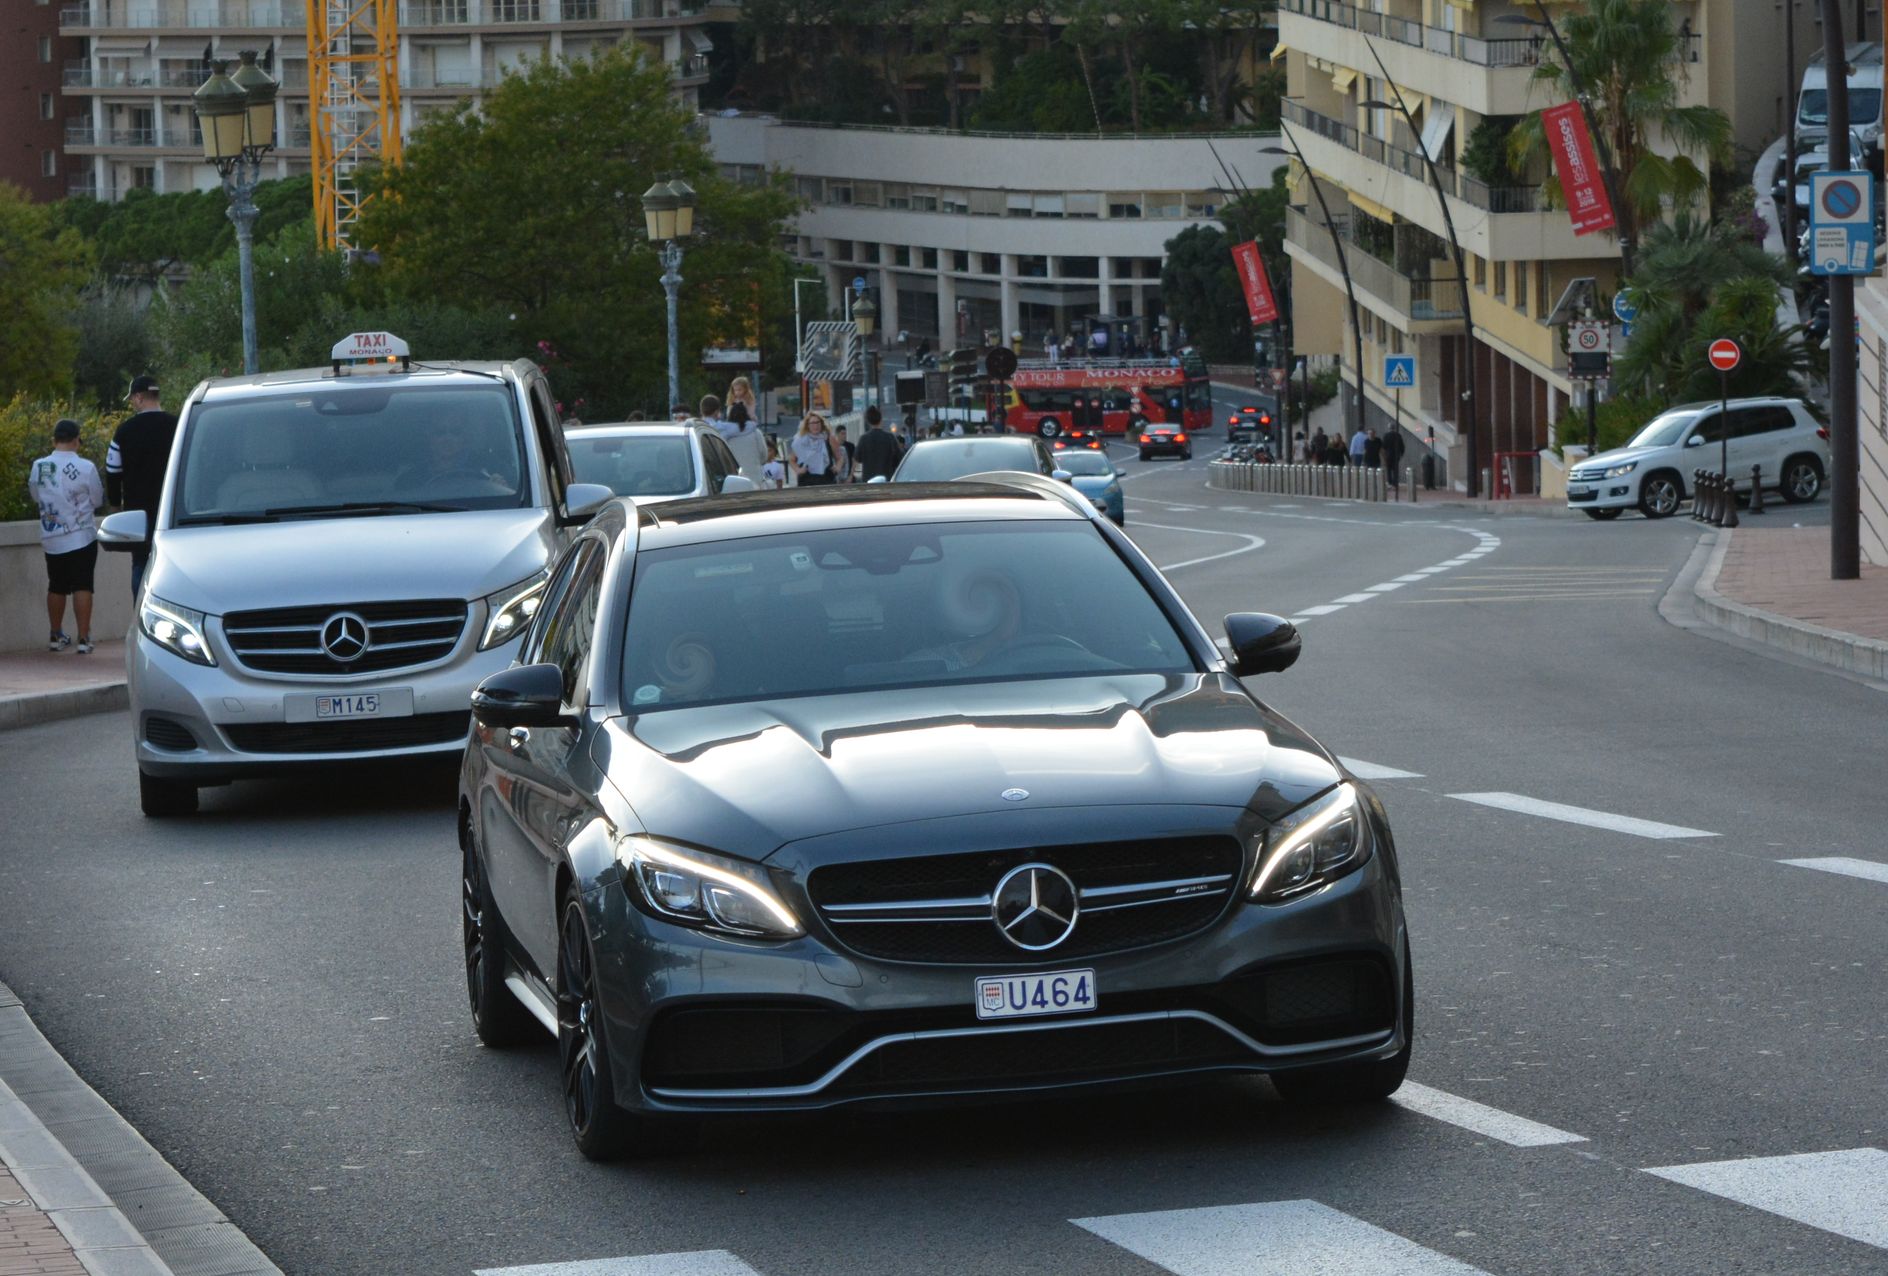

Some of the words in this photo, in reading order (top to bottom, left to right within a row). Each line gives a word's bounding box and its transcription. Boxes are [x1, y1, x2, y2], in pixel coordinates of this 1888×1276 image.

[354, 334, 387, 347] TAXI
[1584, 335, 1594, 344] 50
[1031, 372, 1065, 382] TOUR
[1086, 368, 1177, 378] MONACO
[38, 462, 58, 488] R
[63, 462, 80, 480] 55
[332, 696, 377, 714] M145
[1008, 976, 1091, 1010] U464
